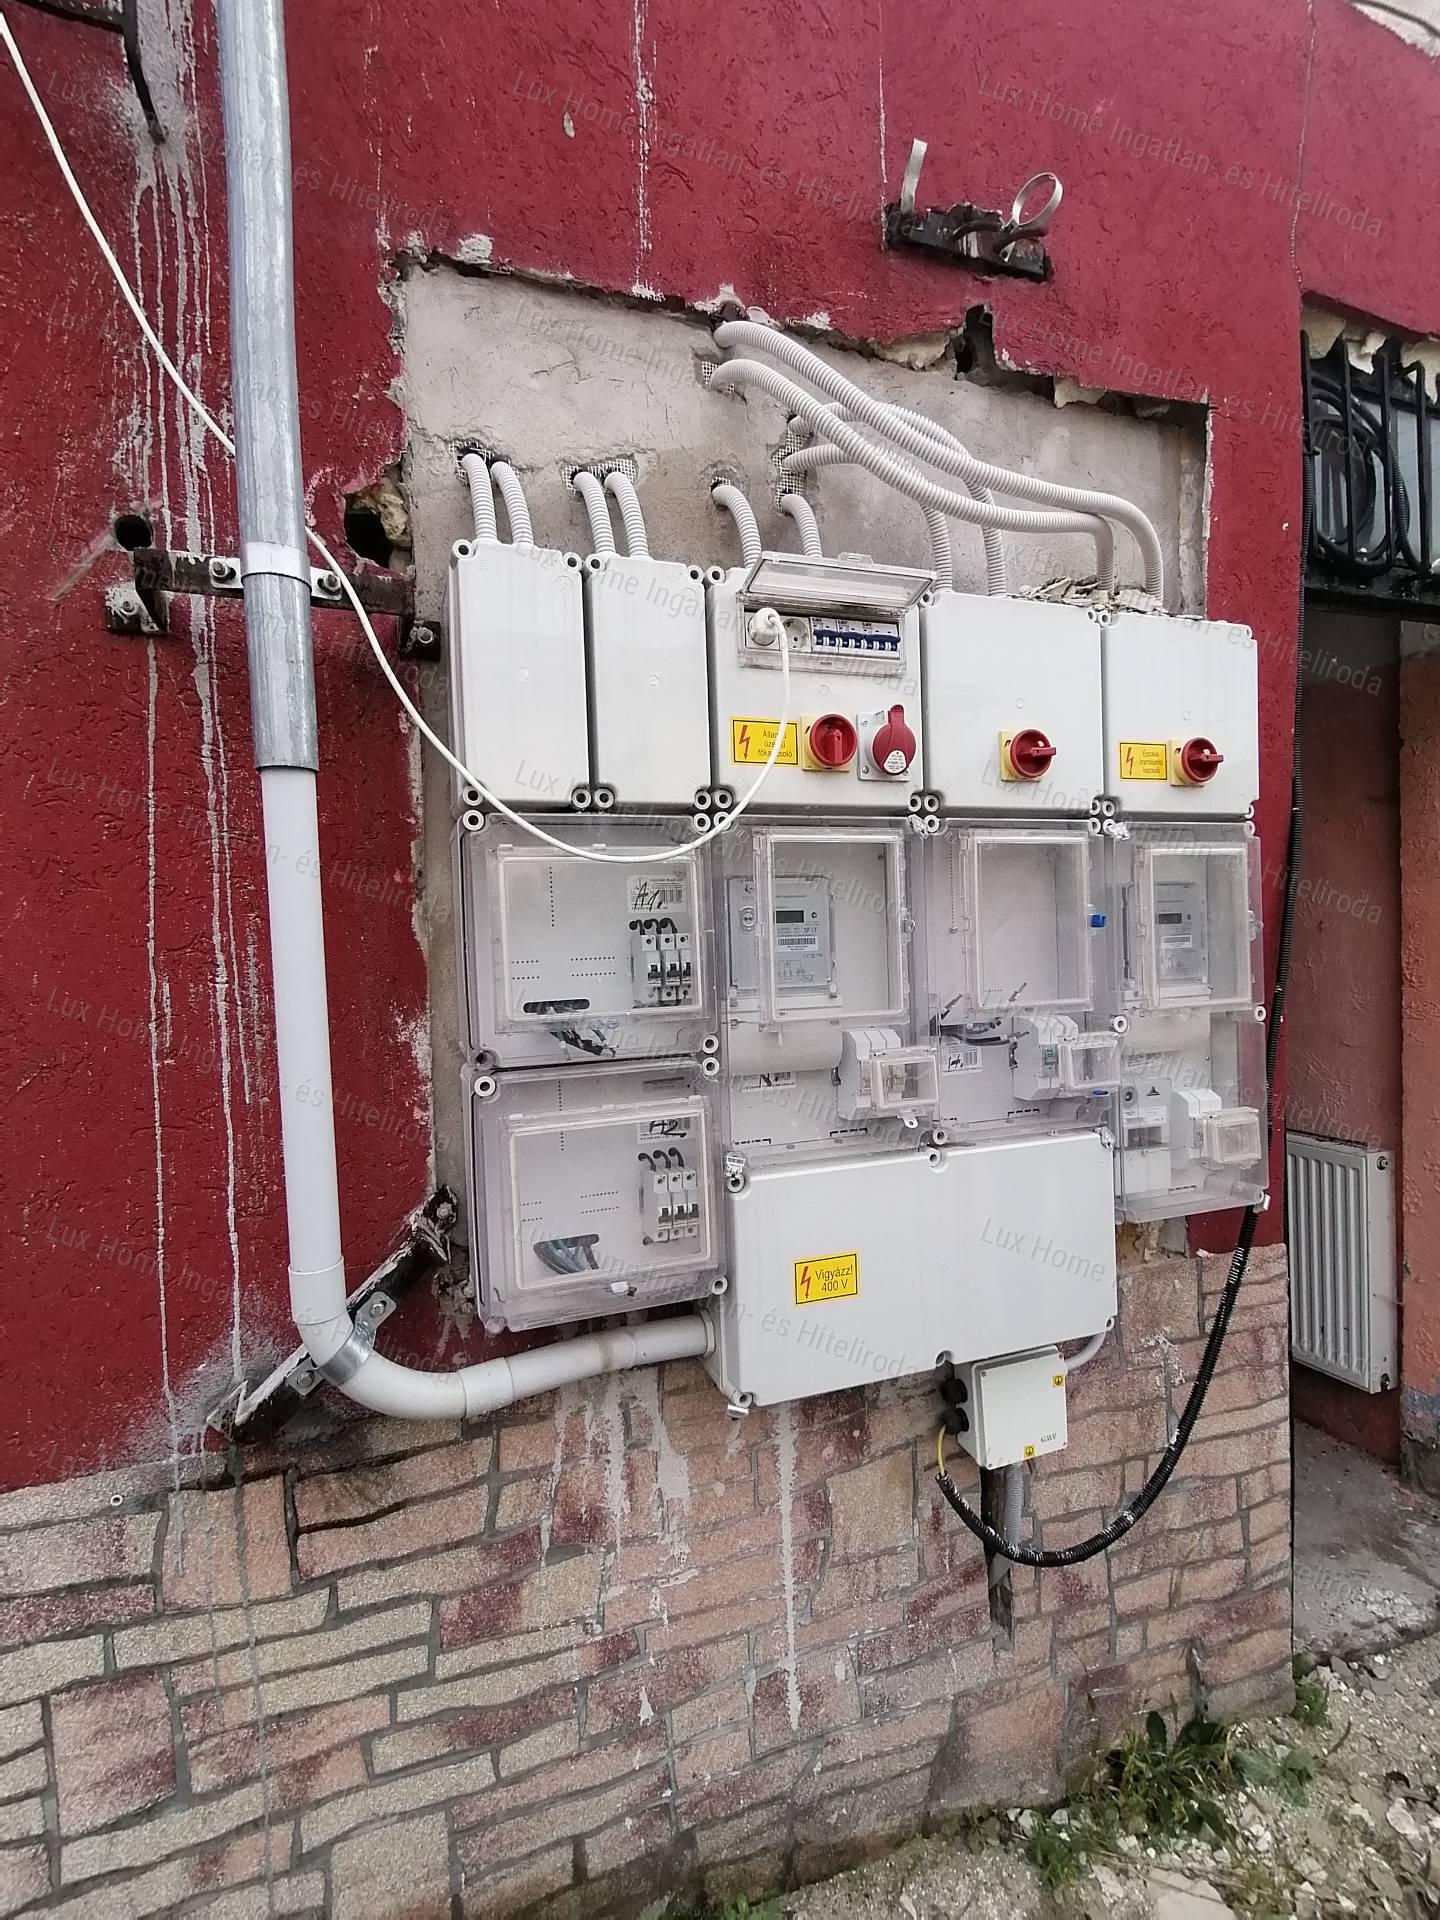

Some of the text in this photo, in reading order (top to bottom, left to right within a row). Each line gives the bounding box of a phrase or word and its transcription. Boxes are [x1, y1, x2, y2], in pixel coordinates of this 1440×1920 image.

[815, 1264, 853, 1282] Vigyázz!
[821, 1278, 848, 1292] 400 V
